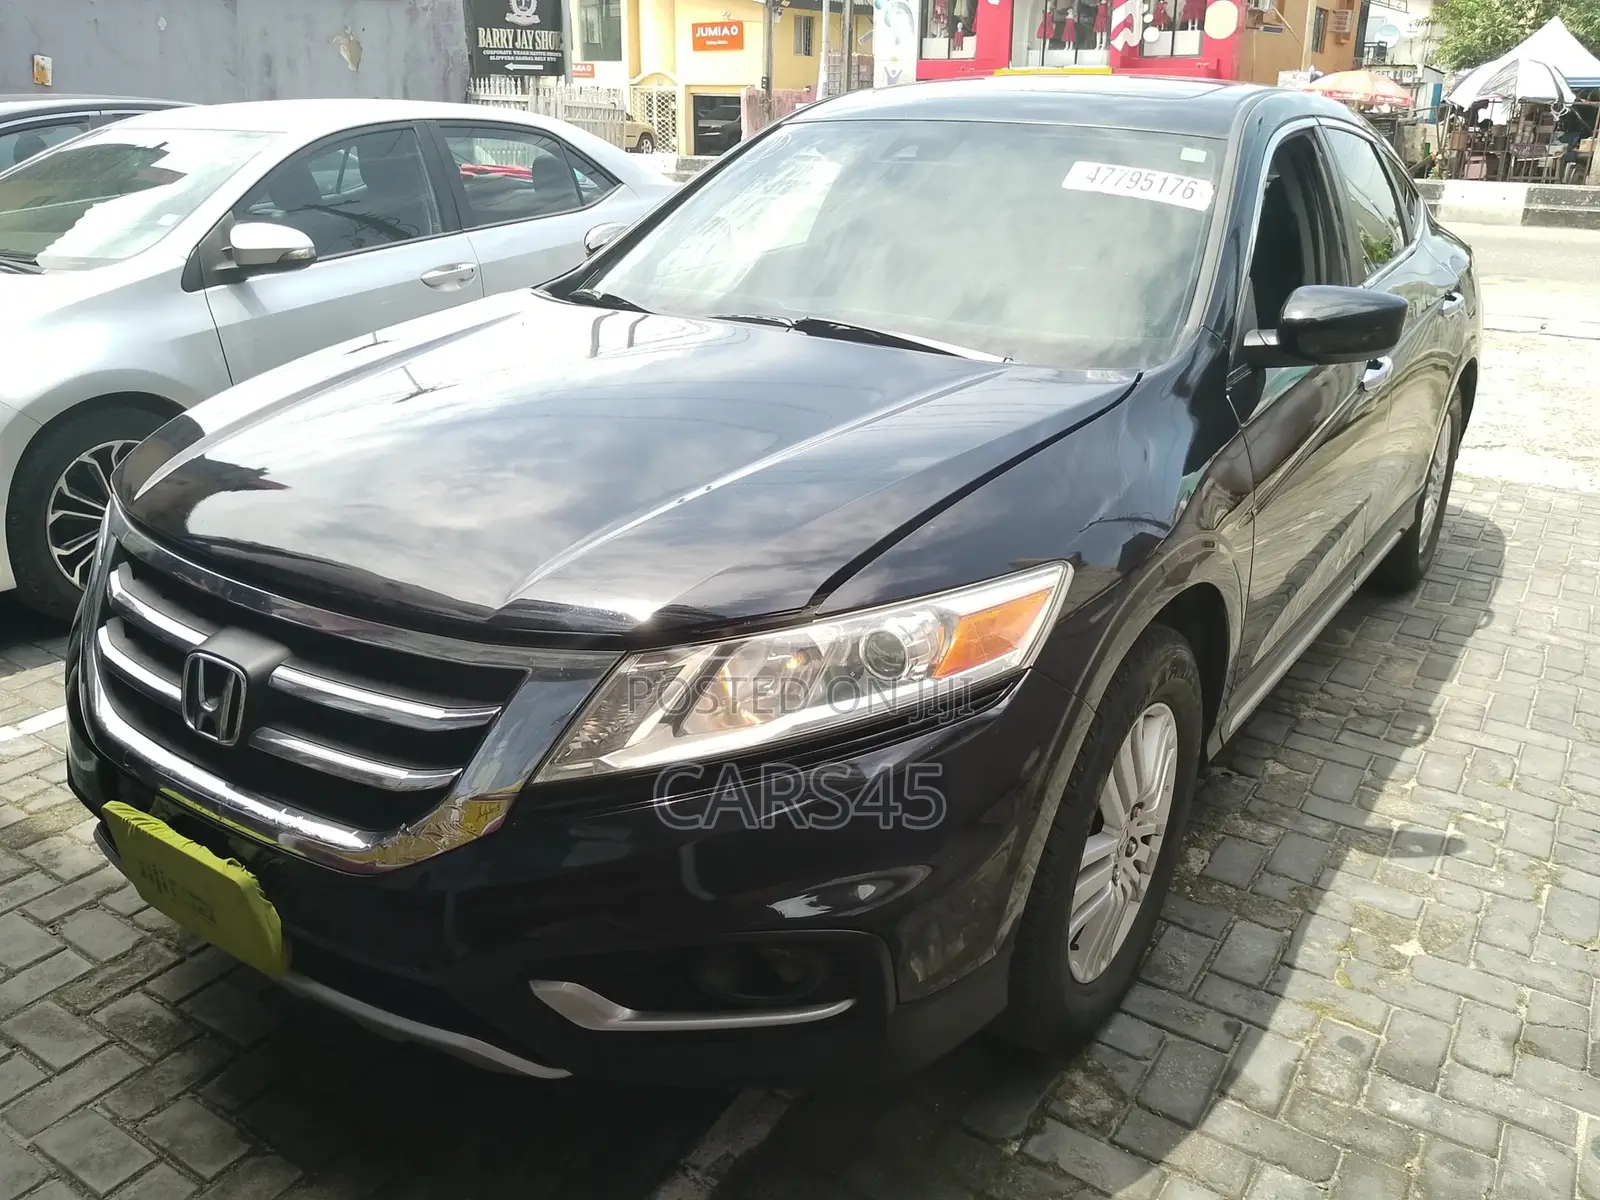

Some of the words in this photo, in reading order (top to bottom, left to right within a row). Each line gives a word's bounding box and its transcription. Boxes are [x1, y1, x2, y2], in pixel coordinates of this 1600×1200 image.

[477, 27, 514, 48] BARRY
[514, 29, 534, 49] JAY
[1086, 166, 1198, 200] 47795176
